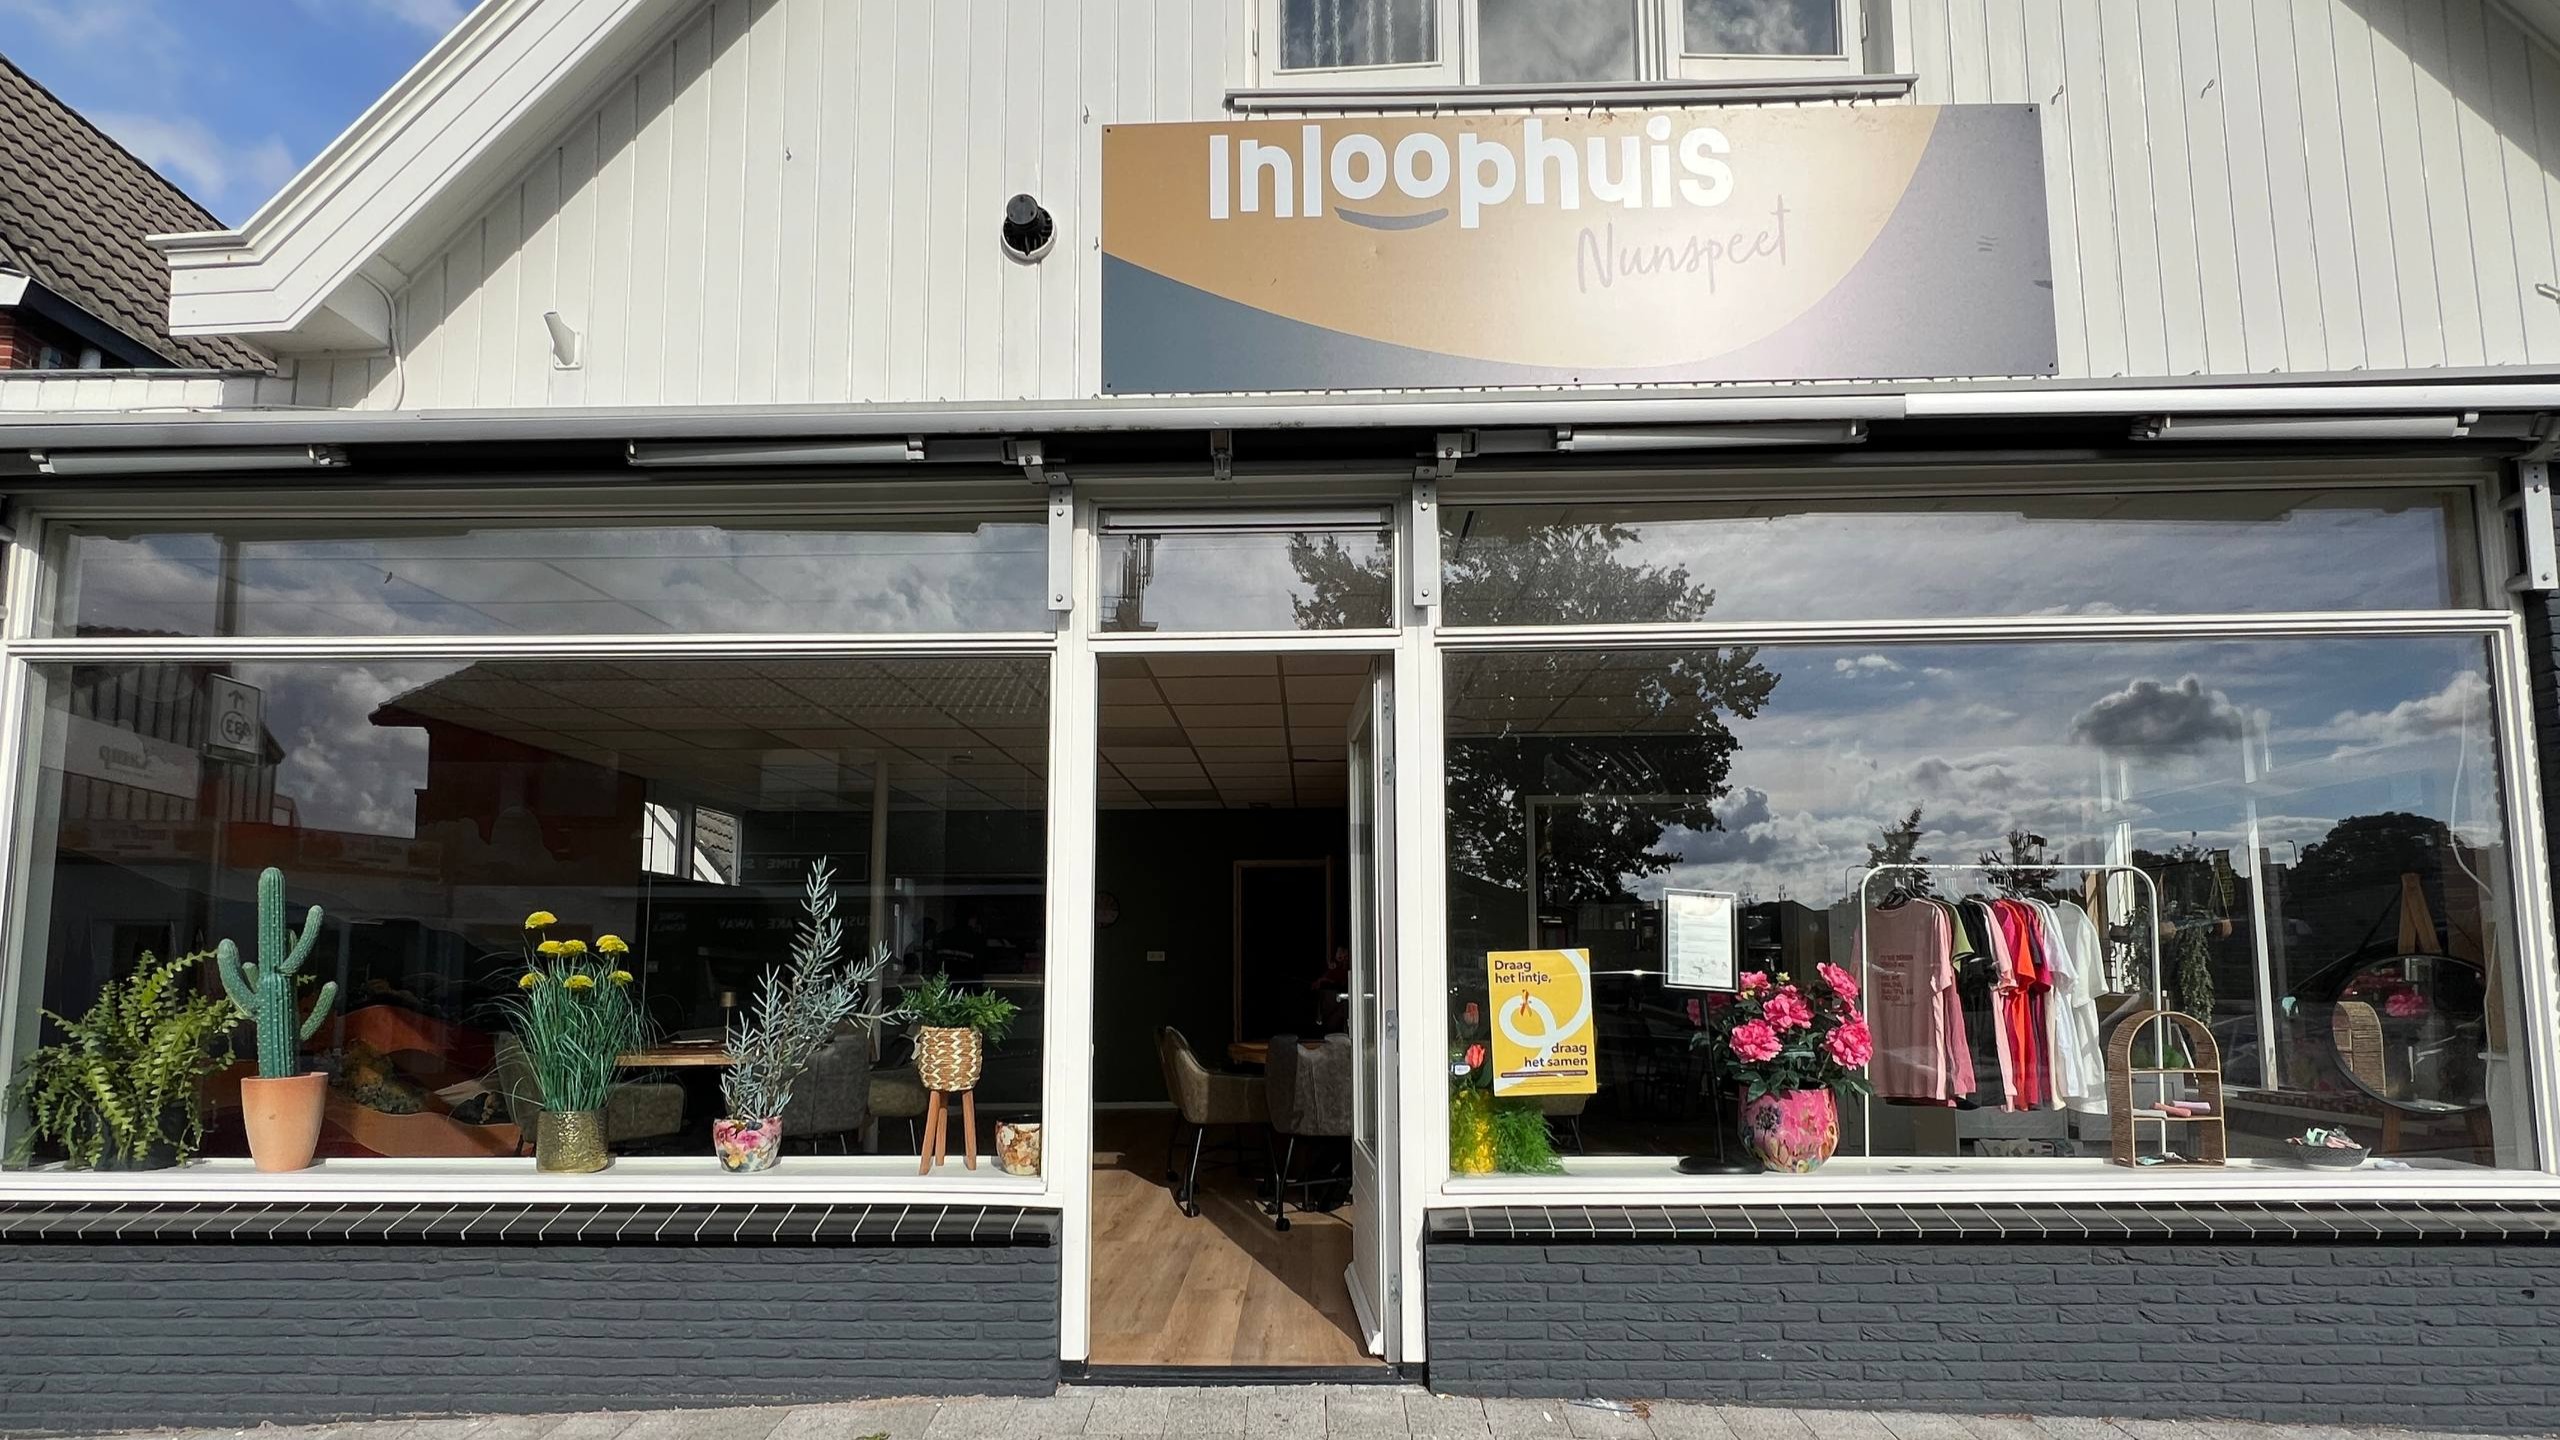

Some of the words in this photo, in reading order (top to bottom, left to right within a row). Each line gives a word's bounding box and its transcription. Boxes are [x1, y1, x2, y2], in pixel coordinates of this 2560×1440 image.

[1209, 115, 1734, 229] Inloophuis
[1577, 194, 1791, 294] Nunspeet
[1494, 960, 1531, 972] Draag
[1495, 972, 1515, 983] het
[1518, 972, 1551, 985] lintje,
[1551, 1043, 1587, 1055] draag
[1524, 1056, 1545, 1067] het
[1547, 1058, 1588, 1066] samen
